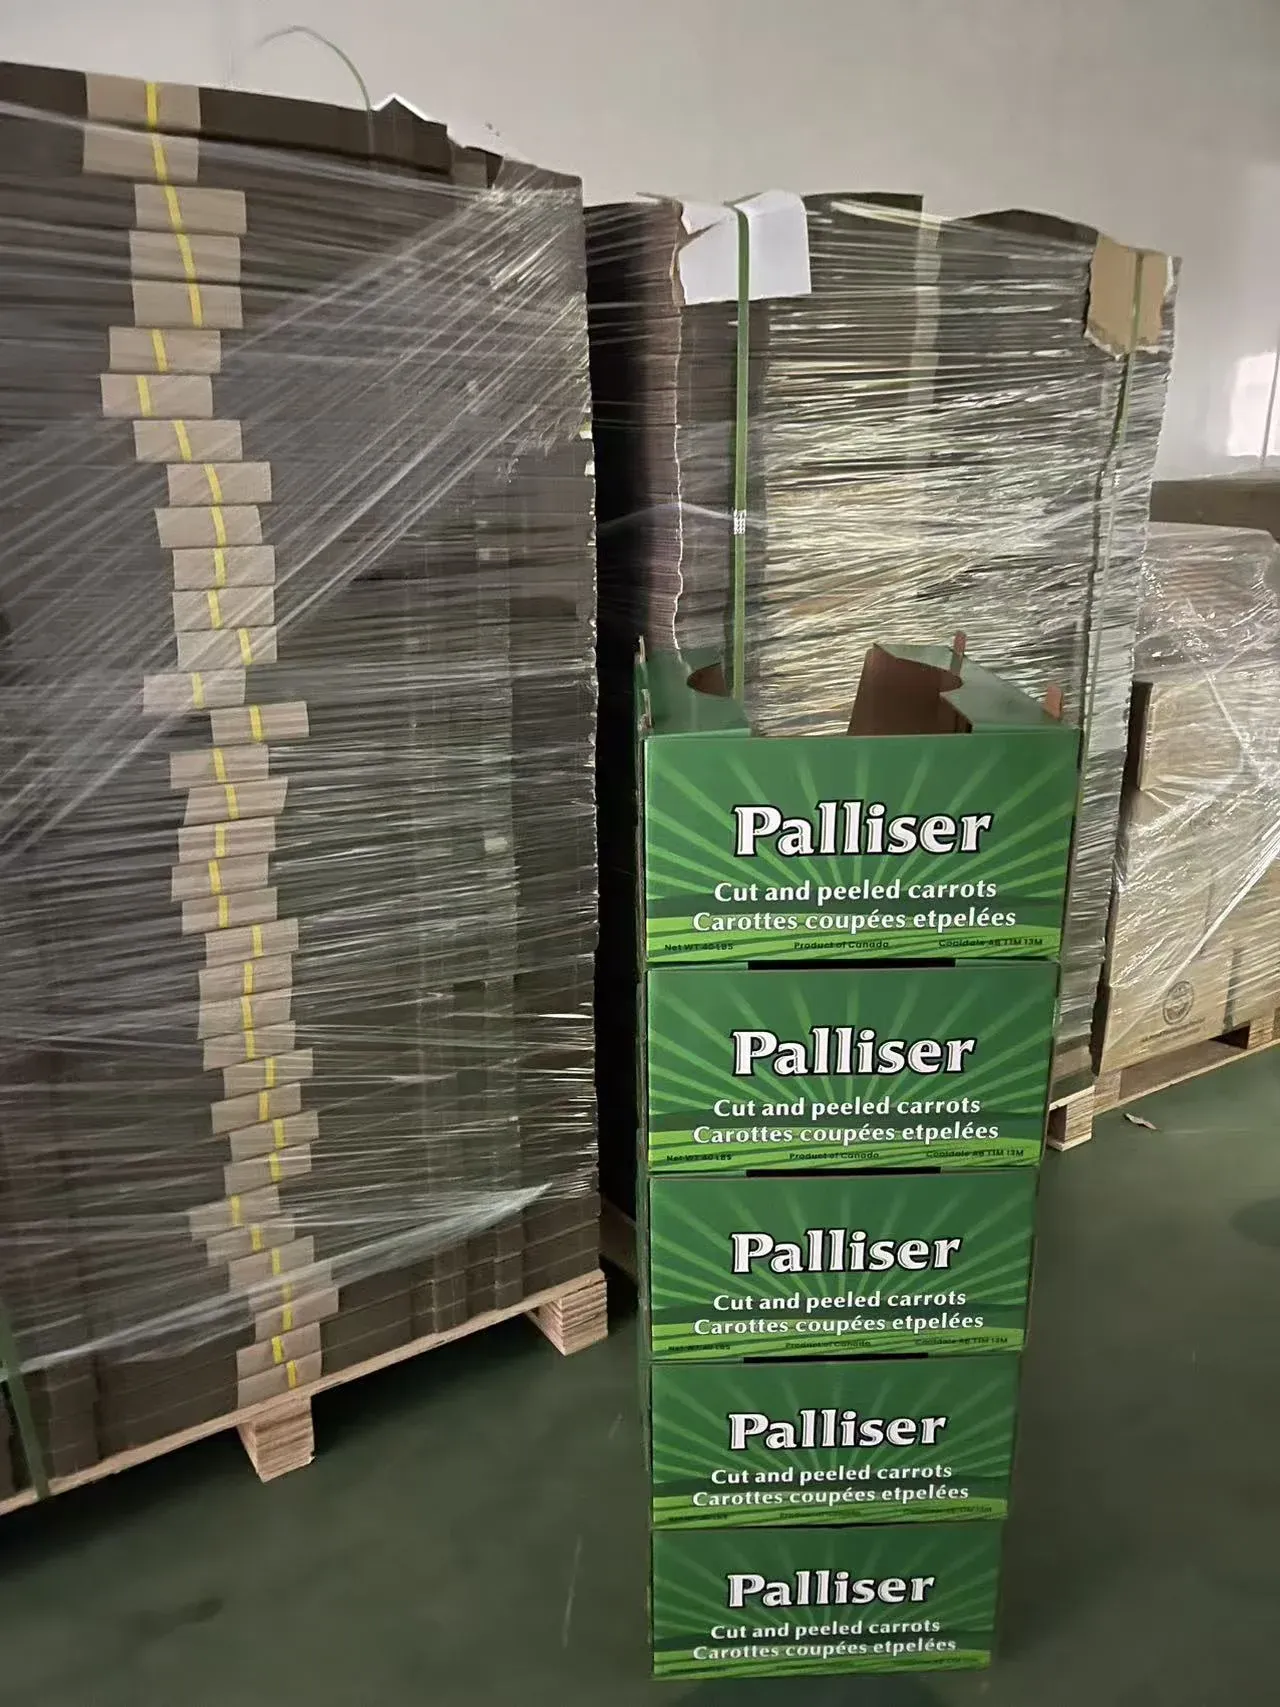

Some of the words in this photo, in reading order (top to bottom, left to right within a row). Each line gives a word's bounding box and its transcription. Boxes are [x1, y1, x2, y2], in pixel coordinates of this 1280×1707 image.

[732, 798, 994, 857] Palliser
[714, 882, 759, 902] Cut
[765, 879, 810, 901] and
[817, 878, 901, 906] peeled
[908, 879, 997, 899] carrots
[693, 911, 798, 931] Carottes
[805, 908, 906, 934] coupées
[913, 906, 1016, 932] etpelées
[794, 941, 833, 949] Product
[730, 1025, 977, 1077] Palliser
[713, 1099, 756, 1117] Cut
[762, 1097, 805, 1116] and
[811, 1096, 890, 1120] peeled
[896, 1097, 980, 1115] carrots
[693, 1126, 793, 1144] Carottes
[800, 1122, 895, 1146] coupées
[902, 1120, 999, 1144] etpelées
[729, 1227, 963, 1275] Palliser
[713, 1294, 753, 1311] Cut
[759, 1292, 800, 1310] and
[806, 1290, 881, 1313] peeled
[887, 1290, 966, 1307] carrots
[694, 1318, 789, 1335] Carottes
[795, 1315, 886, 1336] coupées
[892, 1312, 984, 1334] etpelées
[726, 1407, 948, 1451] Palliser
[711, 1469, 749, 1484] Cut
[754, 1466, 794, 1483] and
[799, 1464, 871, 1486] peeled
[877, 1464, 952, 1480] carrots
[692, 1490, 783, 1507] Carottes
[789, 1486, 876, 1507] coupées
[881, 1483, 969, 1505] etpelées
[725, 1568, 937, 1609] Palliser
[710, 1625, 746, 1639] Cut
[752, 1622, 789, 1638] and
[795, 1620, 863, 1640] peeled
[868, 1619, 940, 1634] carrots
[693, 1645, 779, 1660] Carottes
[785, 1640, 867, 1660] coupées
[873, 1637, 956, 1657] etpelées
